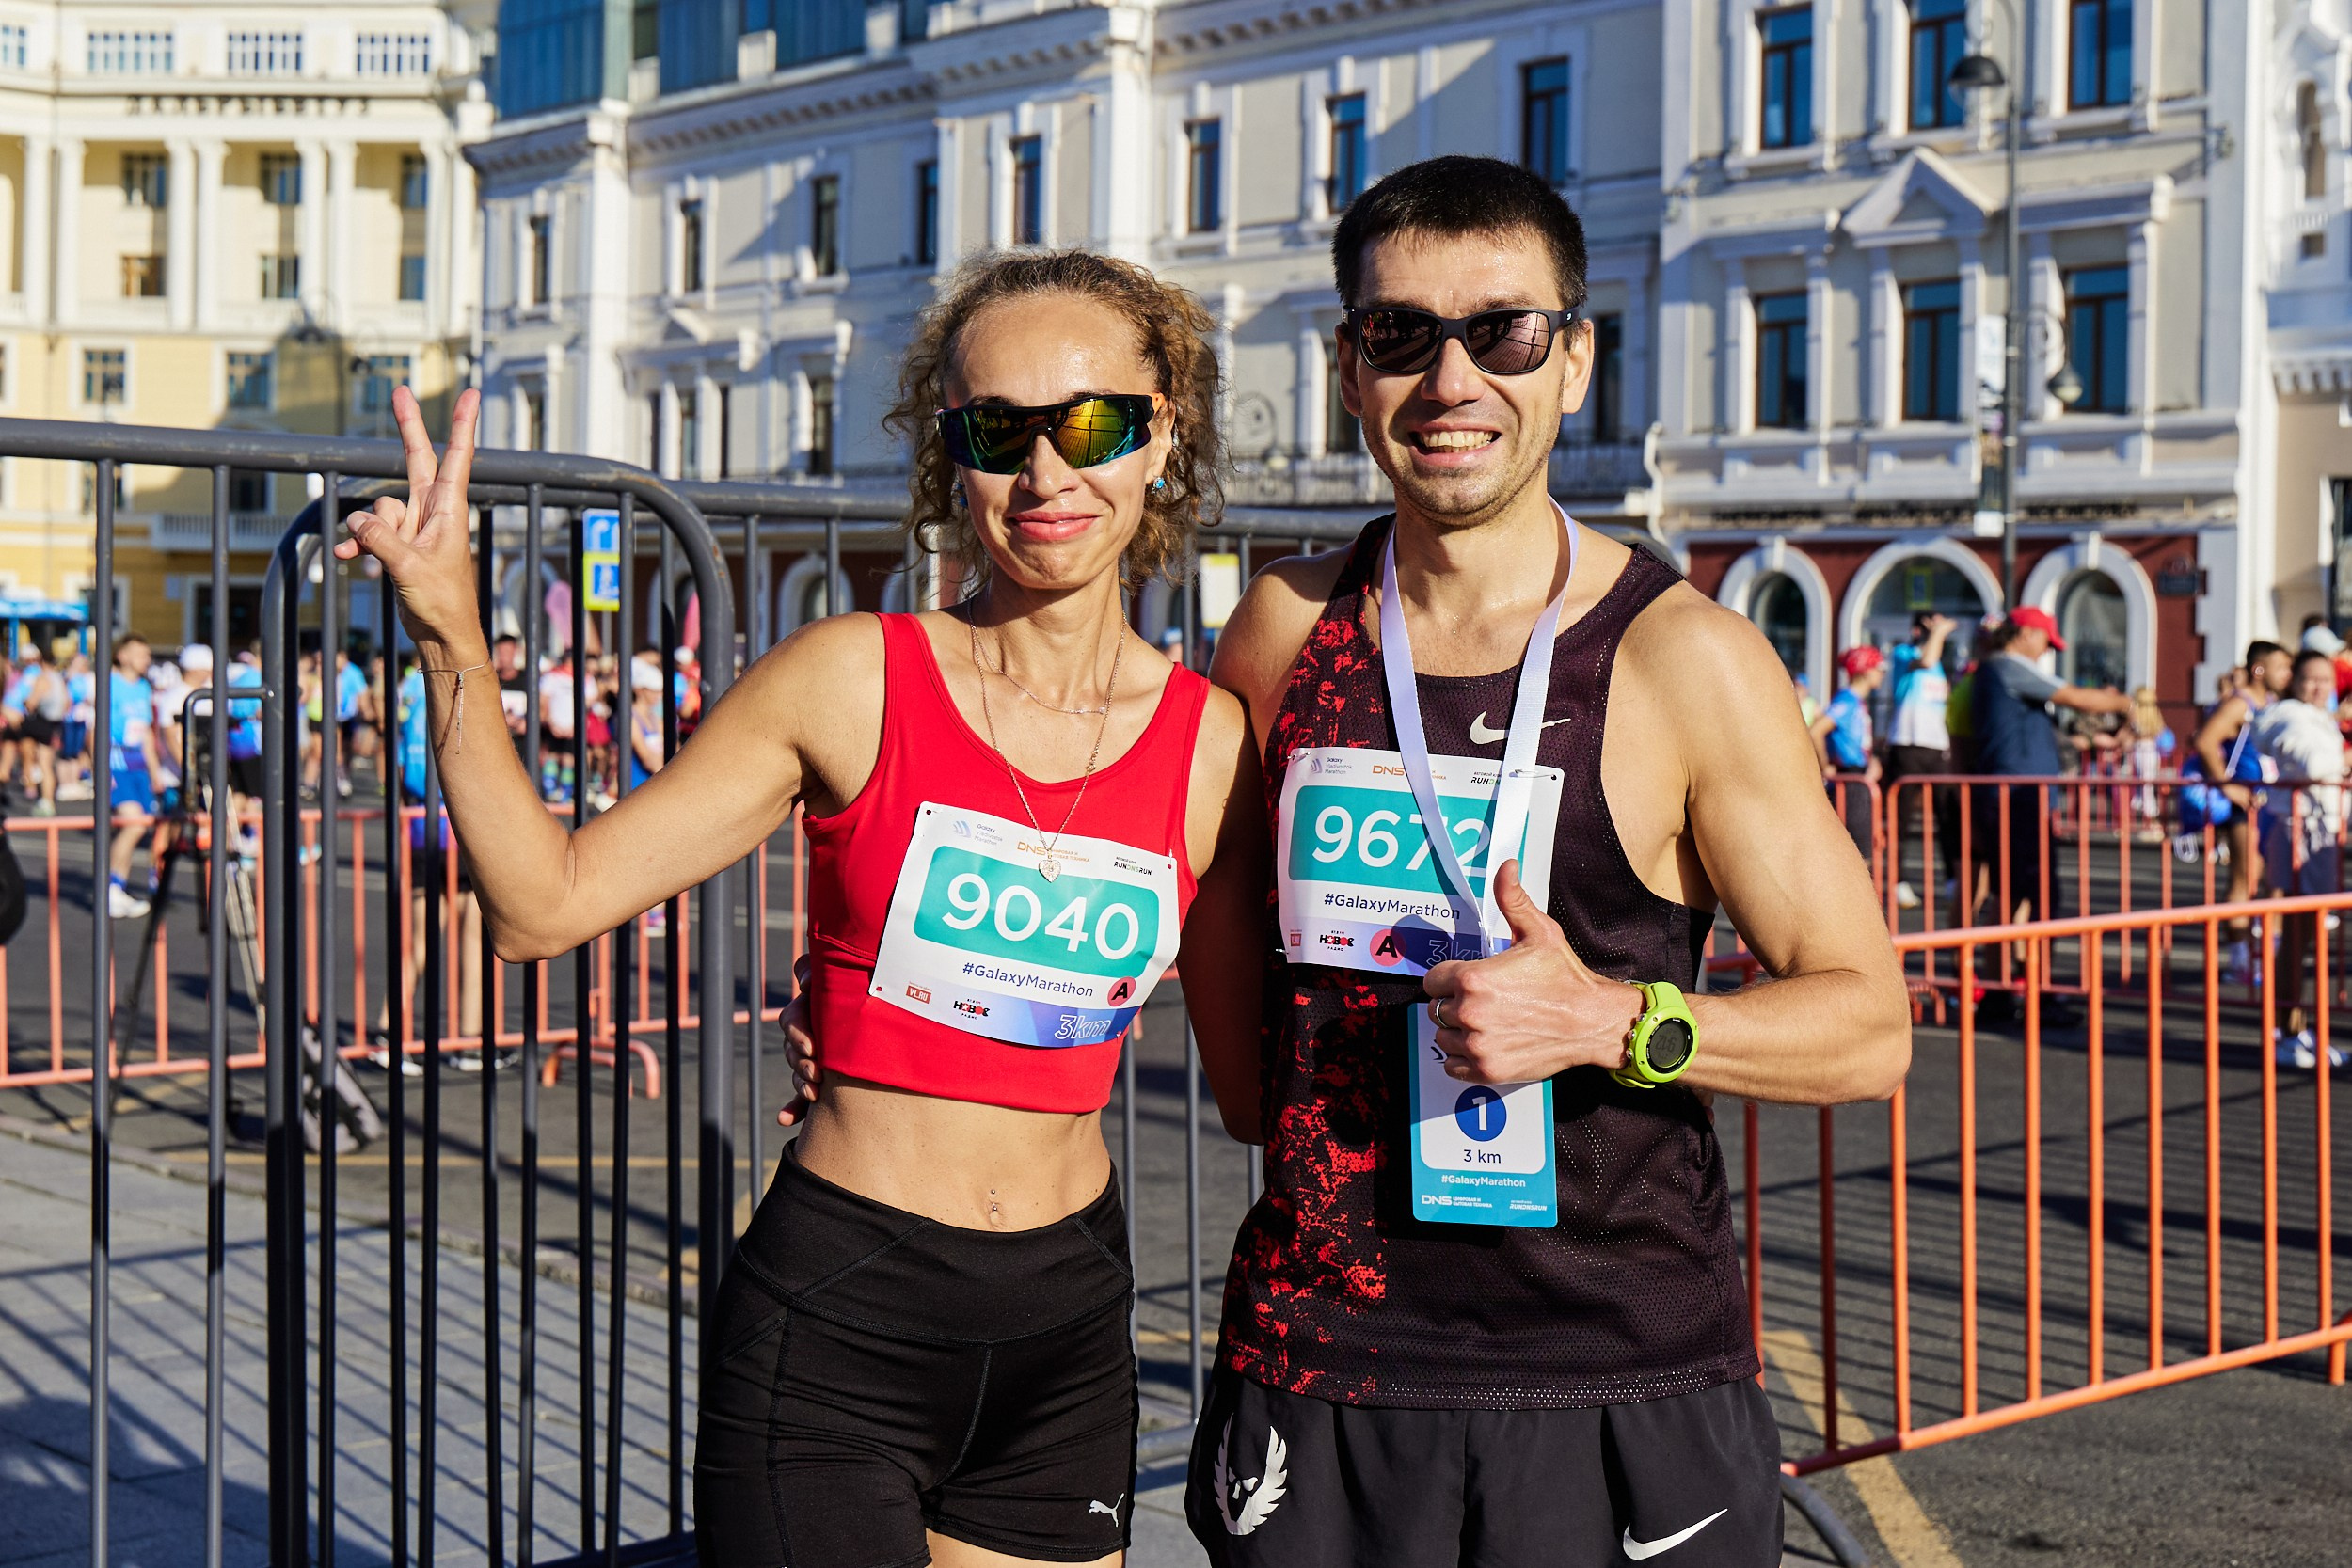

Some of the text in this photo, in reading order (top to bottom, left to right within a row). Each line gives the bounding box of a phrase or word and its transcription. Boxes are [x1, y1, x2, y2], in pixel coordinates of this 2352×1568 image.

[1373, 765, 1405, 776] DNS
[977, 823, 996, 833] Galaxy
[1017, 841, 1046, 856] DNS
[1311, 805, 1491, 878] 9672
[1324, 893, 1460, 920] #GalaxyMarathon
[942, 873, 1139, 960] 9040
[1375, 935, 1399, 958] A
[962, 962, 1093, 998] #GalaxyMarathon
[909, 987, 929, 1002] VL.RU
[1111, 982, 1129, 1001] A
[1054, 1015, 1111, 1039] 3km
[1472, 1096, 1487, 1131] 1
[1463, 1149, 1502, 1164] 3 km
[1441, 1175, 1526, 1188] #GalaxyMarathon
[1421, 1195, 1453, 1206] DNS
